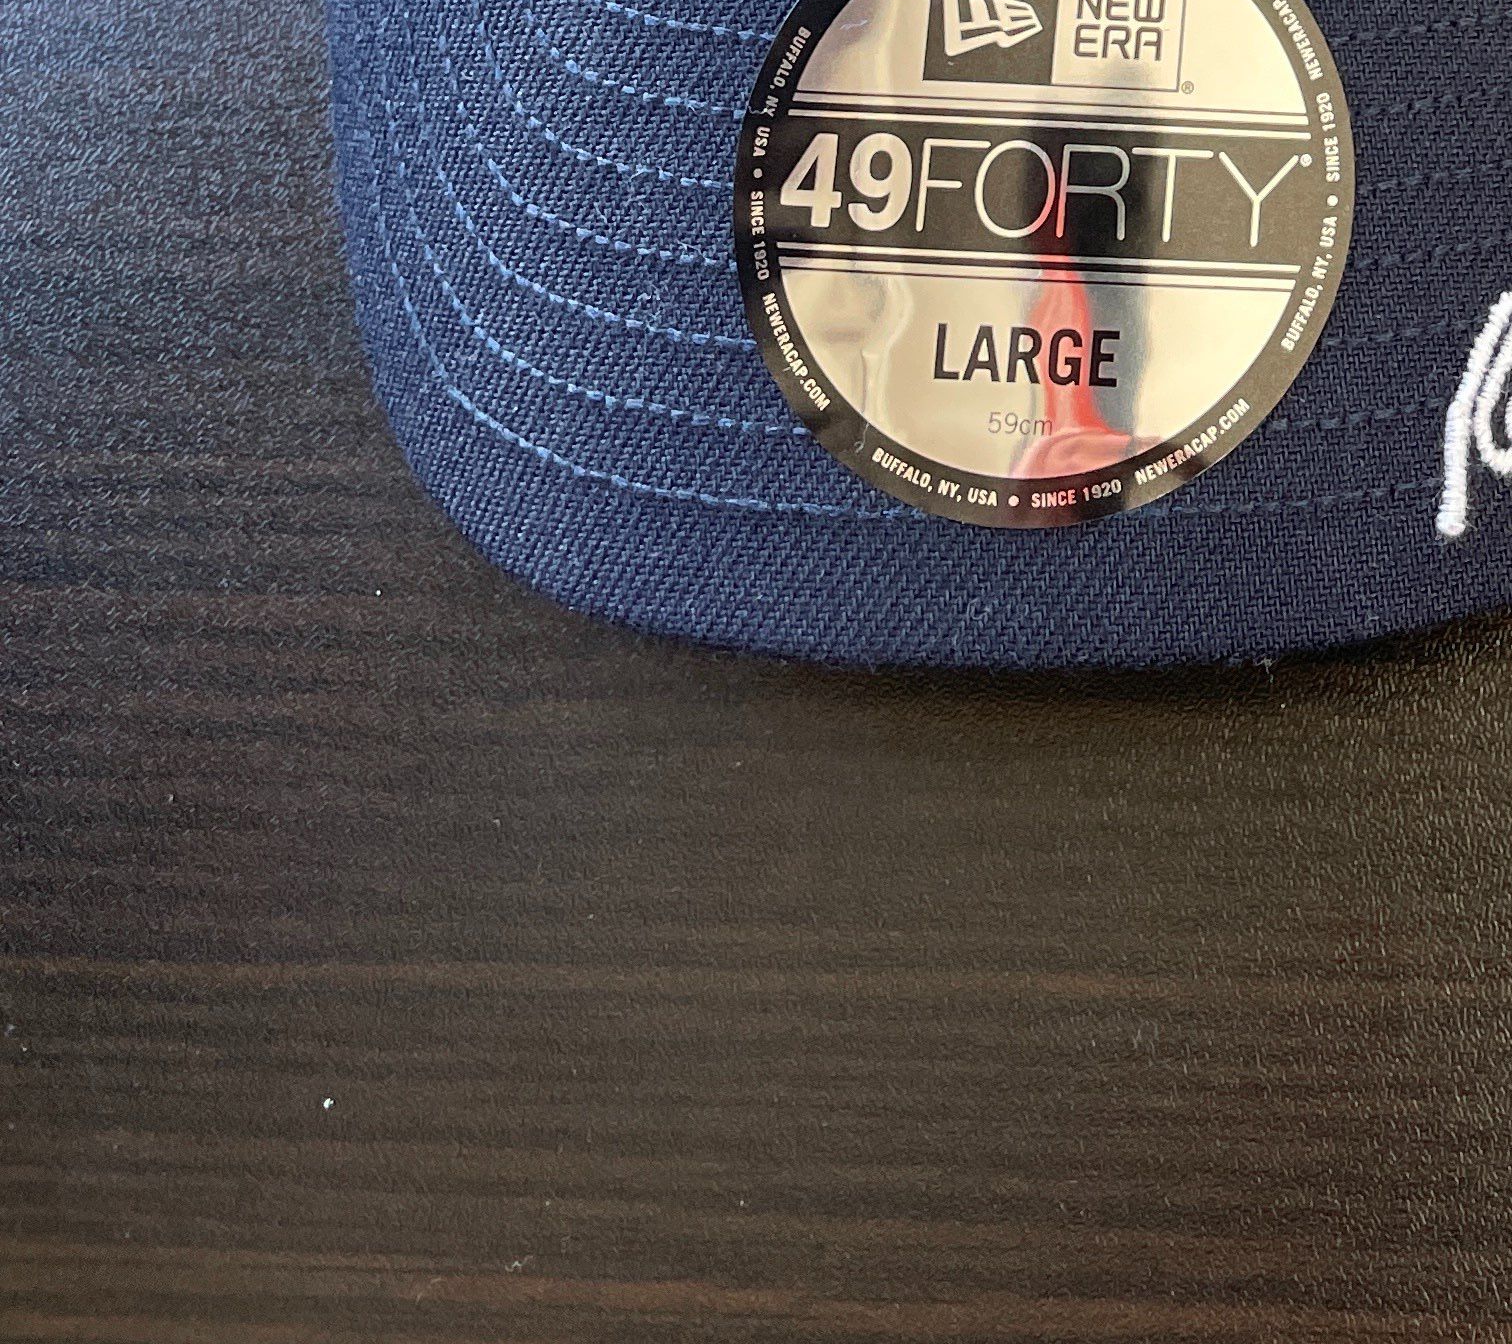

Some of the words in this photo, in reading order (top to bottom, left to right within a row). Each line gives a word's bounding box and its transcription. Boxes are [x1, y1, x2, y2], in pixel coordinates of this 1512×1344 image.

[769, 26, 812, 90] BUFFALO,
[1073, 23, 1162, 62] ERA
[1316, 92, 1336, 132] 1920
[752, 126, 771, 158] USA
[1323, 136, 1340, 182] SINCE
[750, 190, 765, 236] SINCE
[1319, 215, 1338, 249] USA
[753, 240, 770, 281] 1920
[1311, 253, 1334, 280] NY,
[1280, 284, 1324, 352] BUFFALO,
[762, 292, 831, 412] NEWERACAP.COM
[933, 322, 1121, 388] LARGE
[987, 412, 1053, 437] 59cm
[1031, 489, 1077, 508] SINCE
[1082, 478, 1122, 502] 1920
[1134, 398, 1250, 486] NEWERACAP.COM
[871, 447, 933, 493] BUFFALO,
[937, 479, 962, 503] NY,
[967, 487, 998, 507] USA
